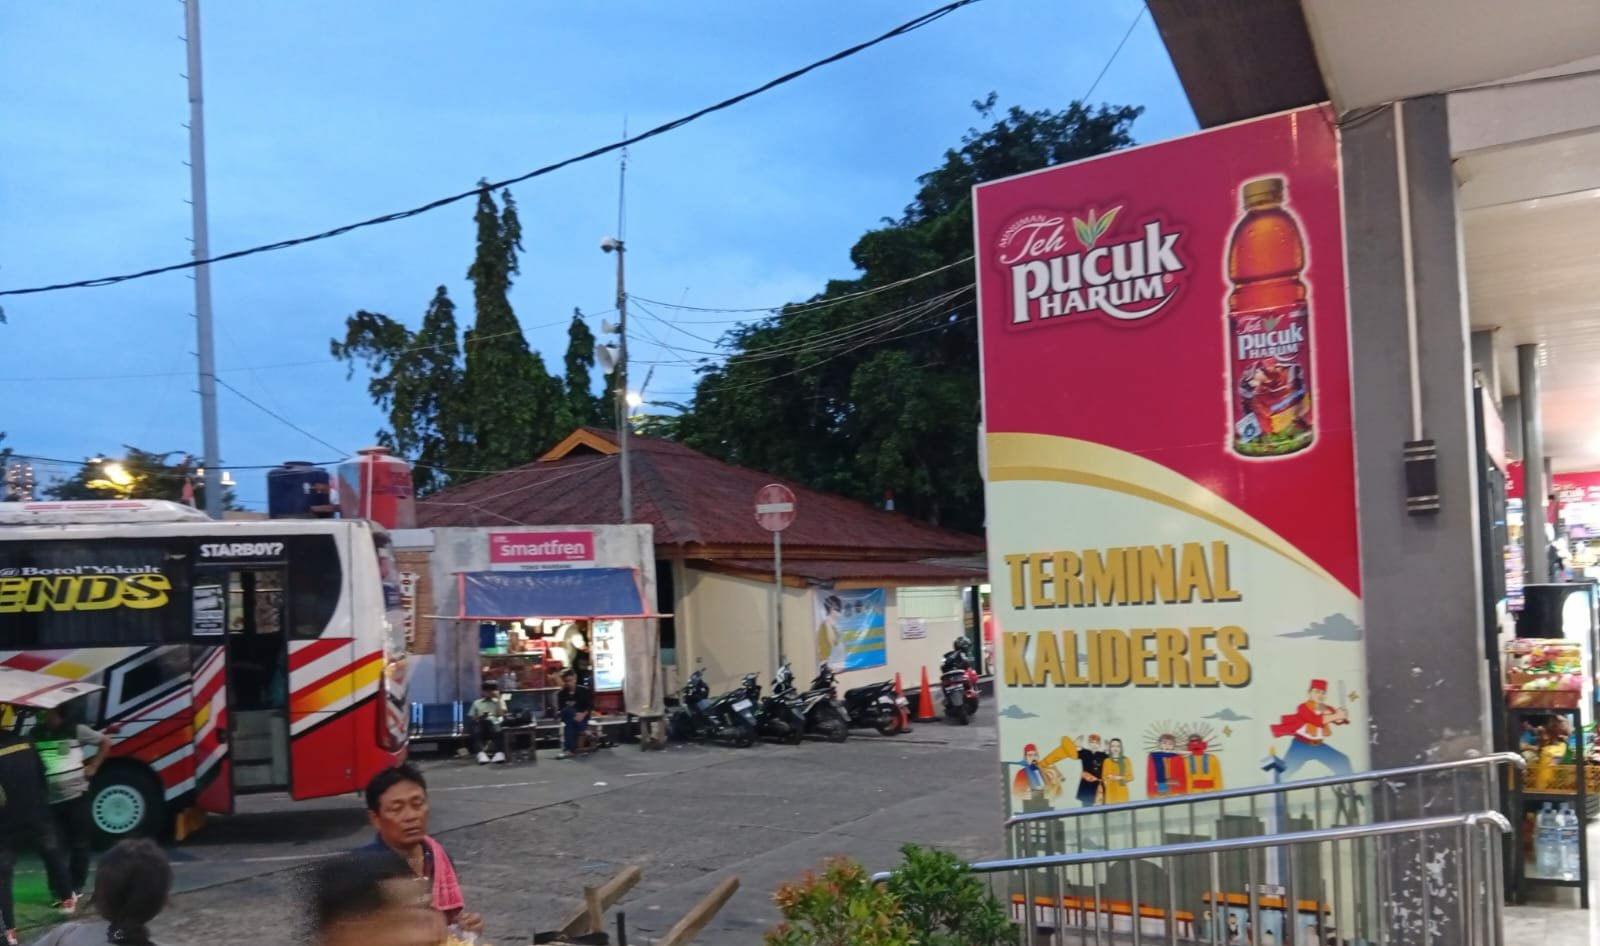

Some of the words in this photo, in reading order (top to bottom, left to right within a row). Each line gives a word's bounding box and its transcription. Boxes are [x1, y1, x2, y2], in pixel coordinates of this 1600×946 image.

[1000, 217, 1066, 264] Teh
[1012, 220, 1184, 323] pucuk
[1039, 274, 1176, 320] HARUM
[1238, 322, 1304, 360] pucuk
[1249, 344, 1299, 361] HARUM
[200, 543, 284, 558] STARBOY?
[500, 540, 585, 557] smartfren
[1004, 540, 1242, 610] TERMINAL
[1002, 626, 1252, 688] KALIDERES
